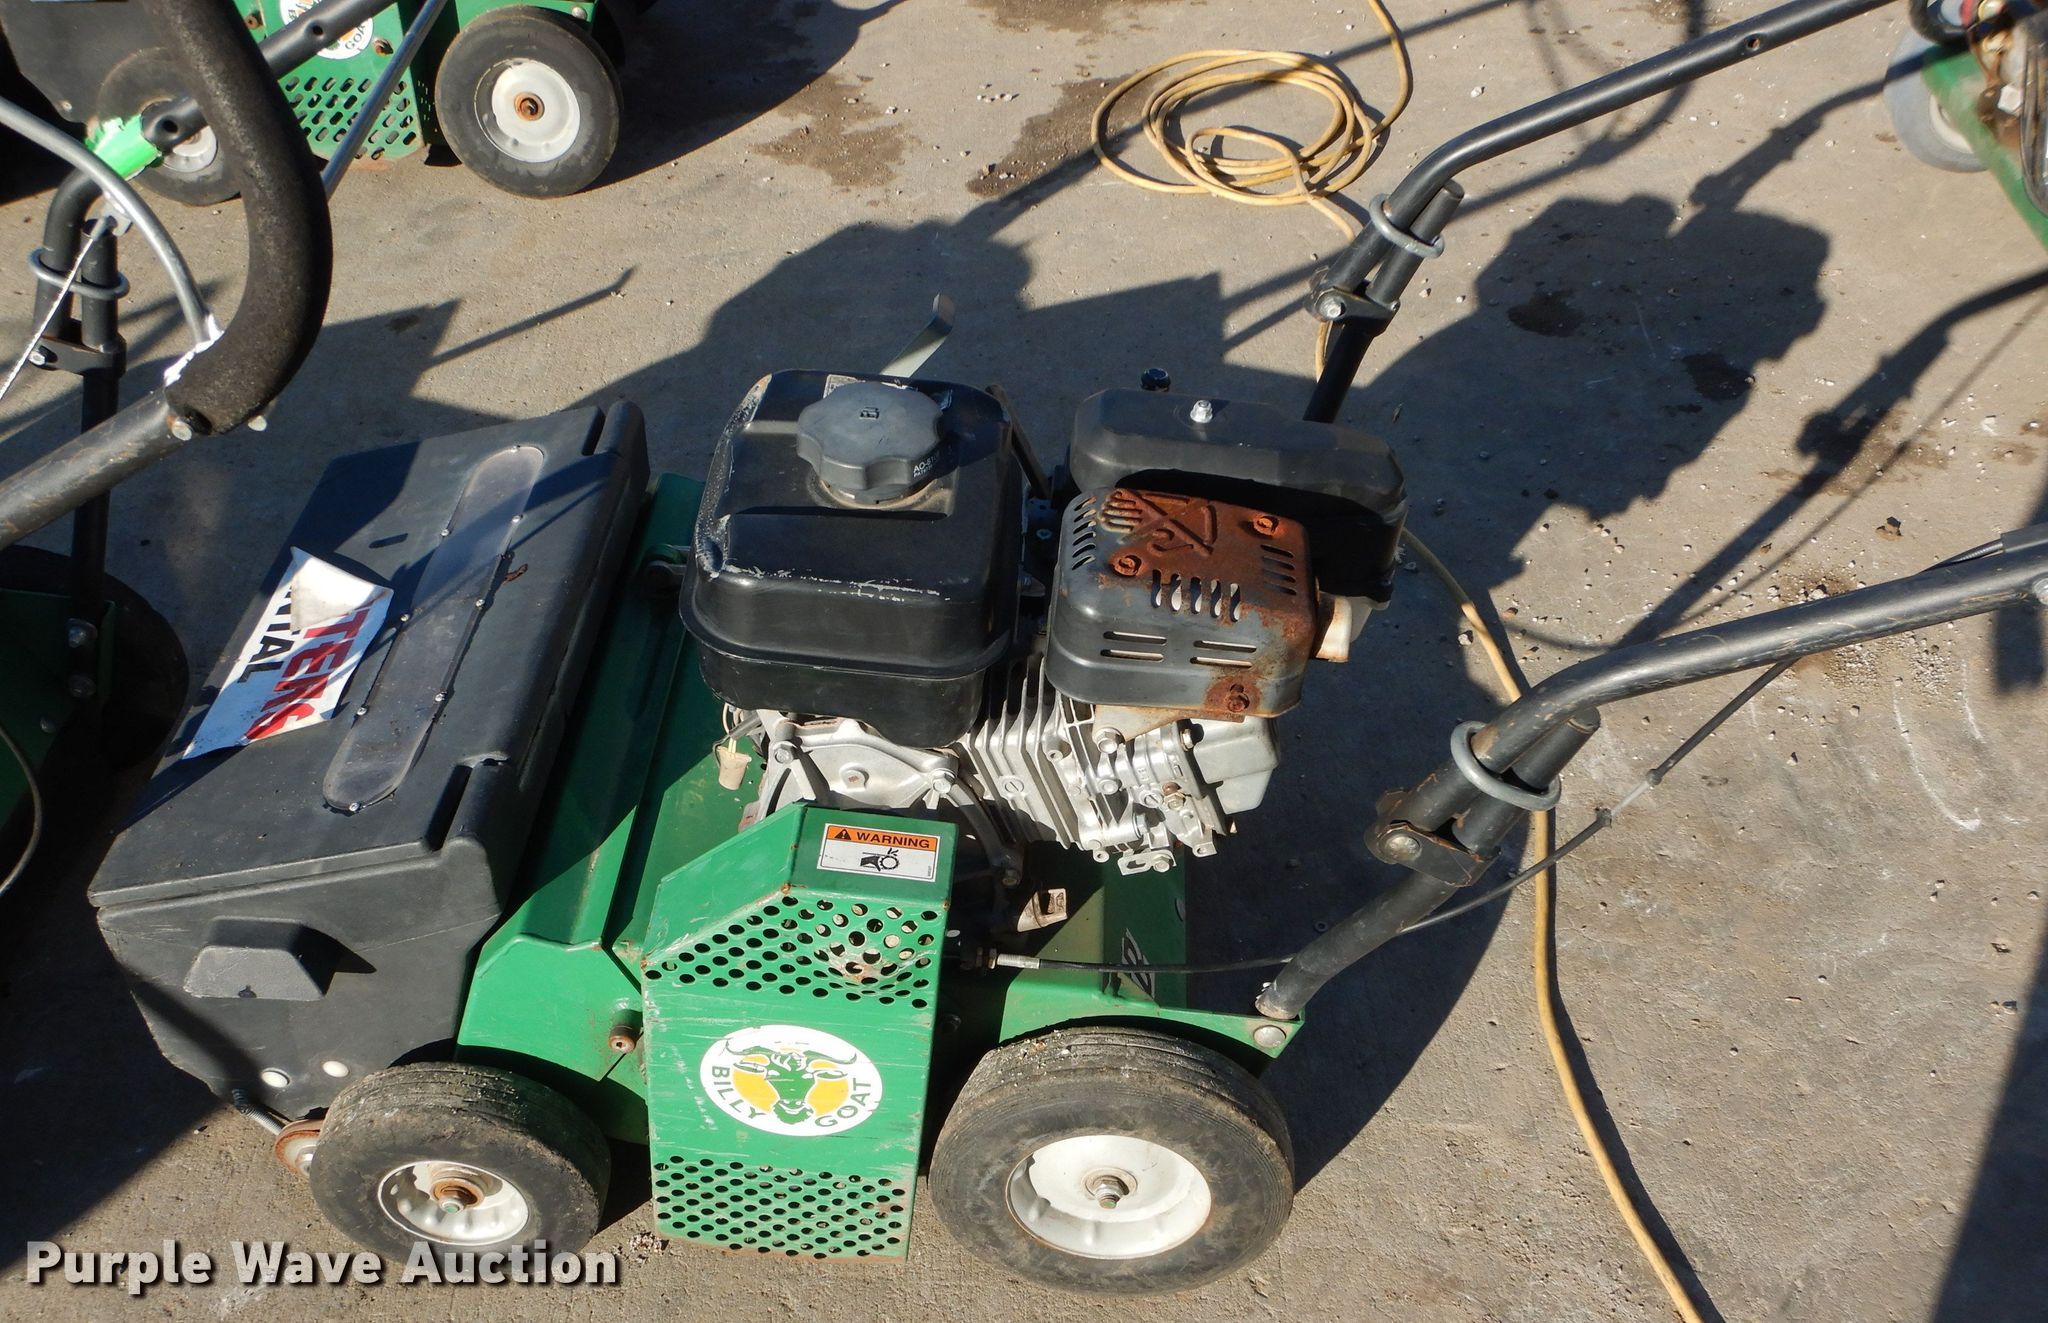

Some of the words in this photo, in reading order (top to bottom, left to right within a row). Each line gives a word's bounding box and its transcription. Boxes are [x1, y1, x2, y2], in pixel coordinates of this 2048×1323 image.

[856, 831, 931, 849] WARNING
[711, 1065, 766, 1120] BILLY
[814, 1077, 872, 1128] GOAT
